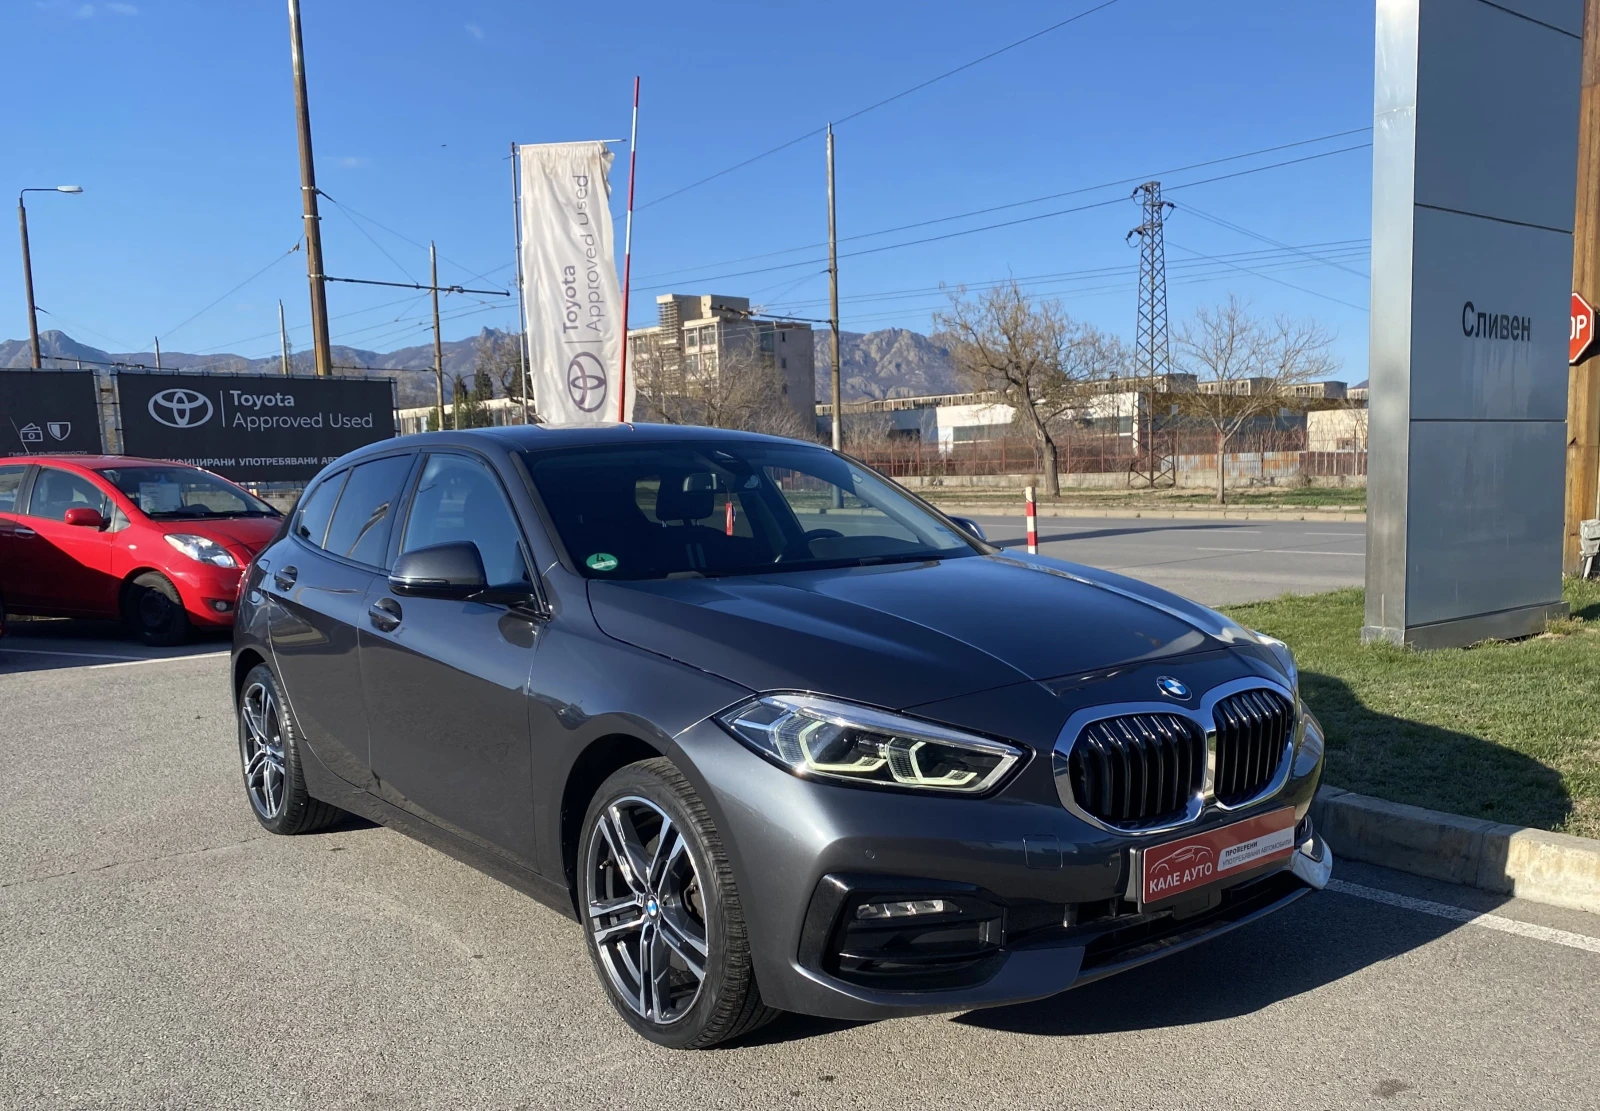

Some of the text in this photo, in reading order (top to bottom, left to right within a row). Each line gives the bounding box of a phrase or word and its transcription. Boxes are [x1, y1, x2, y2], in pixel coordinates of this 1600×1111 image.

[580, 234, 605, 332] Approved
[563, 265, 581, 334] Toyota
[1462, 301, 1531, 342] Сливен
[230, 390, 295, 410] Toyota
[233, 412, 373, 432] Approved Used
[239, 457, 318, 467] УПОТРЕБЯВАНИ
[1225, 841, 1258, 857] ПРОВЕРЕНИ
[1150, 862, 1213, 894] КАЛЕ АУТО
